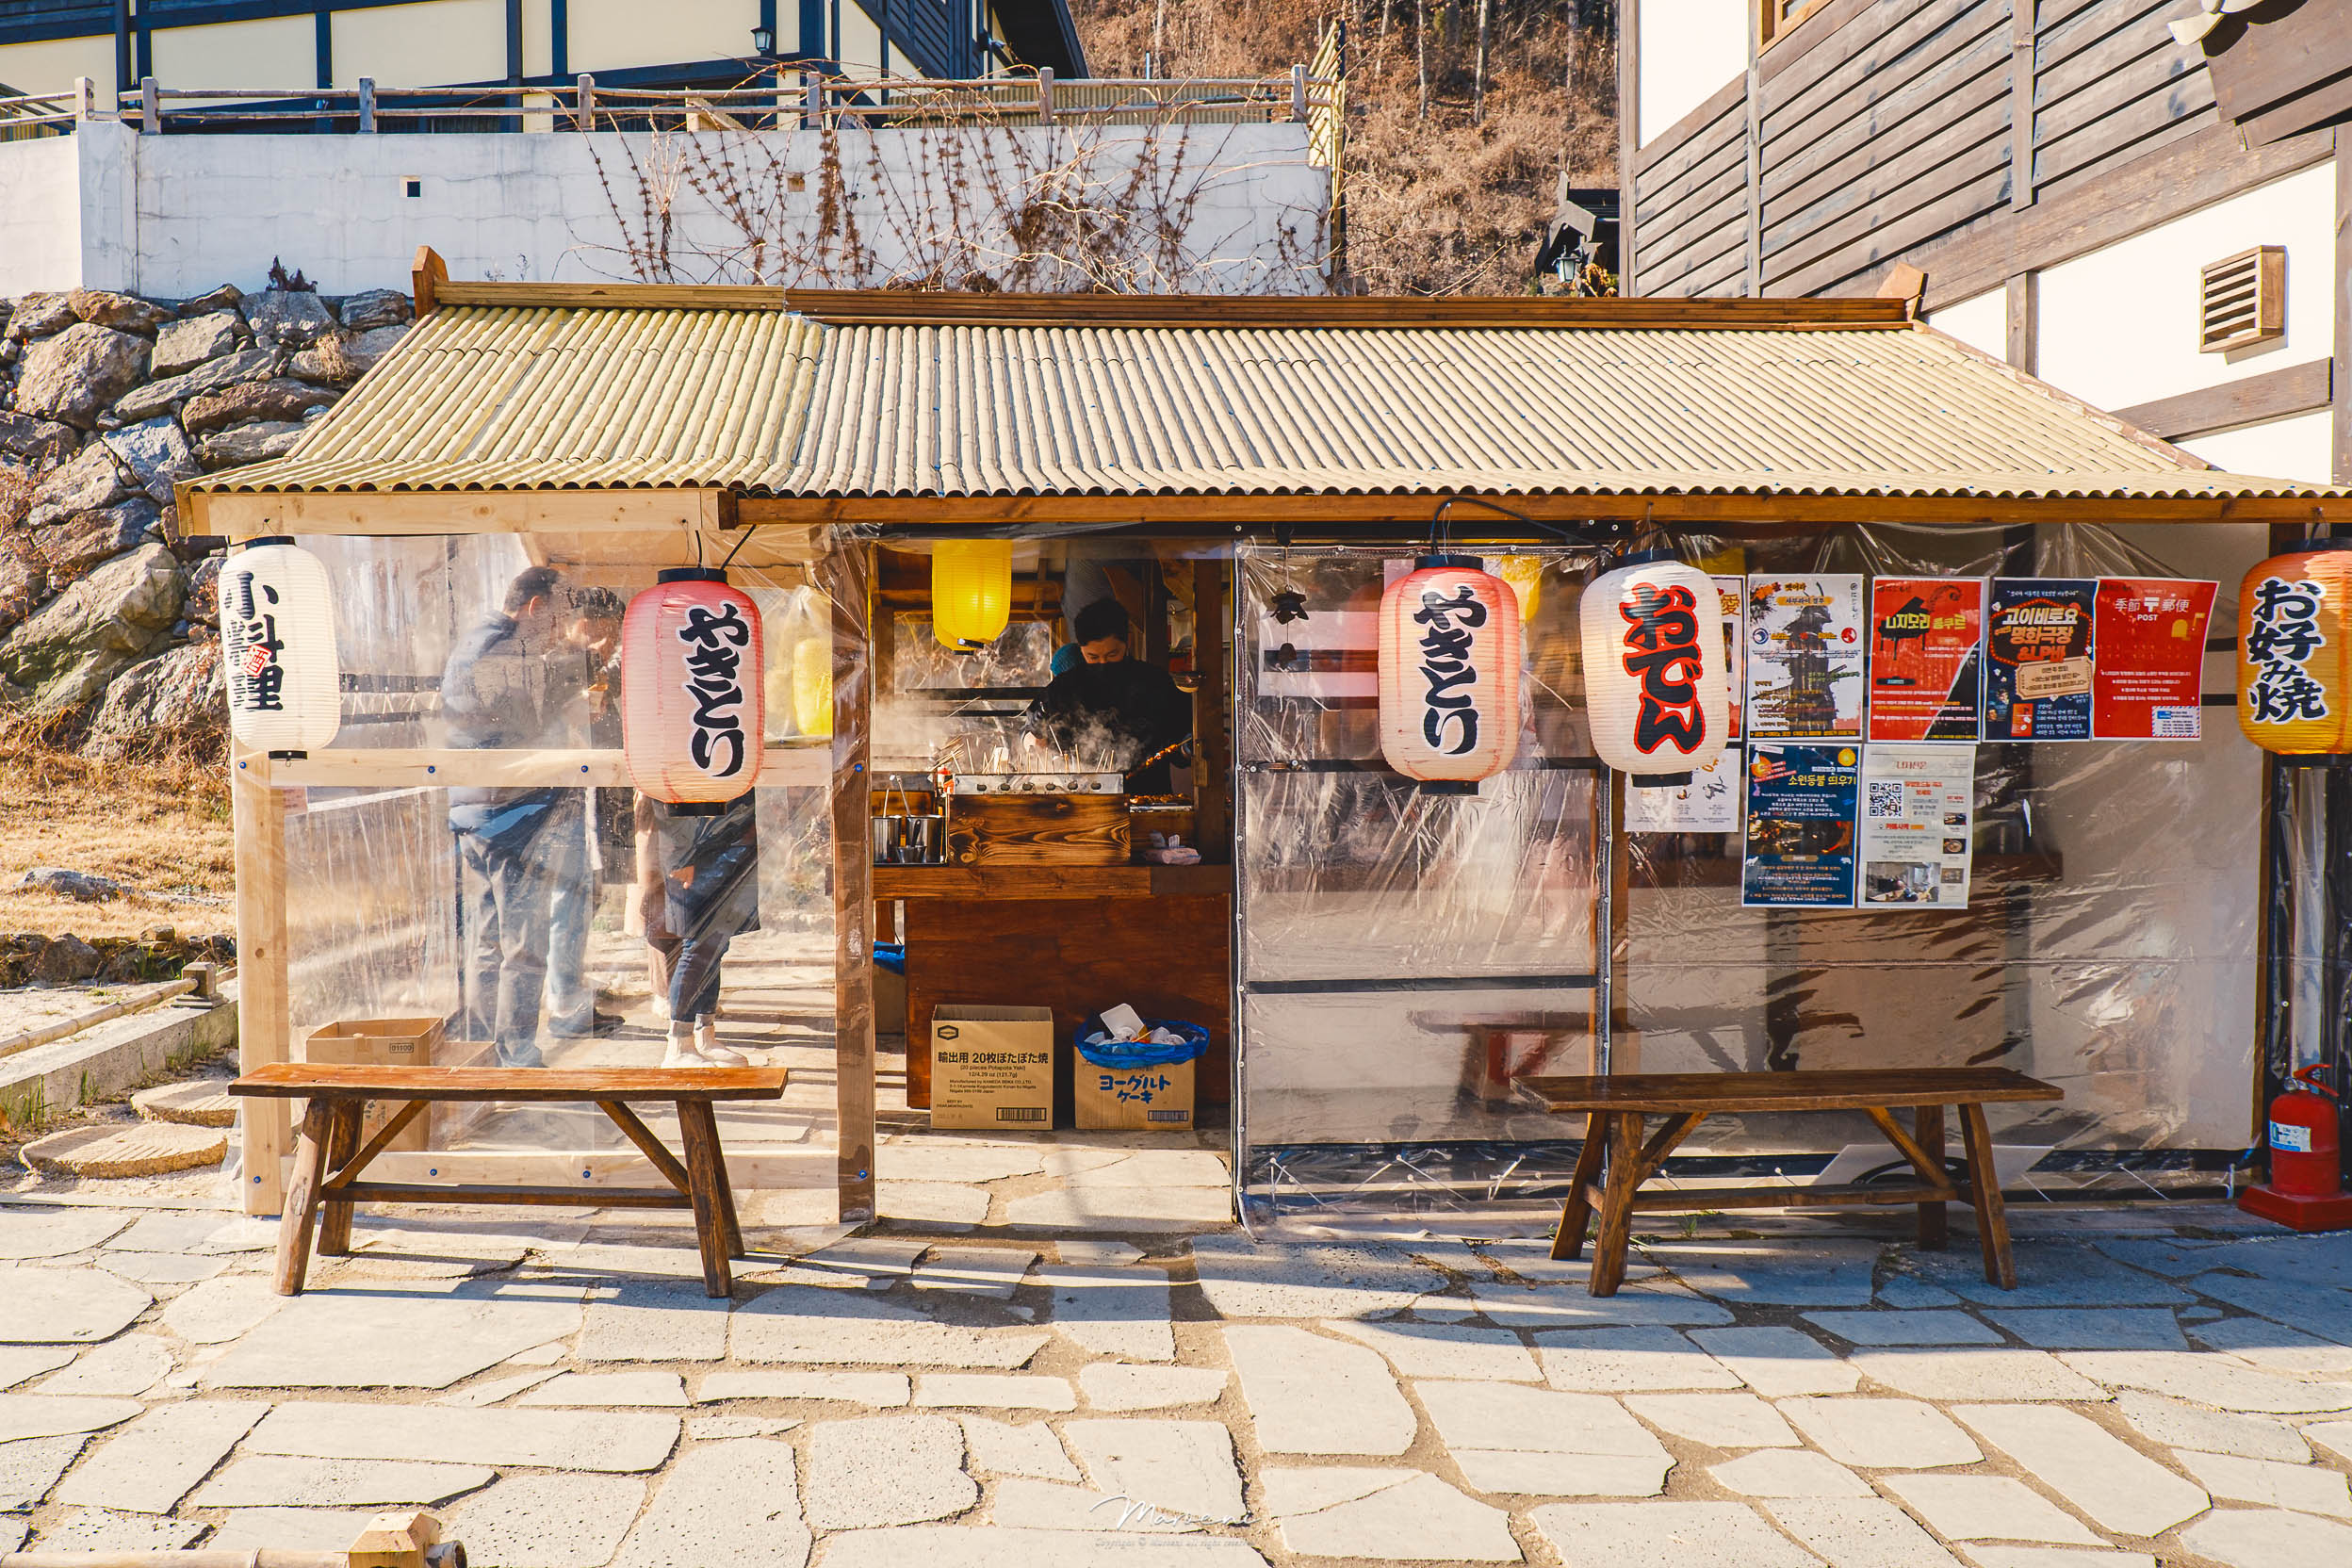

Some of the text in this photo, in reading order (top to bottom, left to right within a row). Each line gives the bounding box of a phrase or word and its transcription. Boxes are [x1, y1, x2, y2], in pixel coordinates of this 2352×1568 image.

[1721, 593, 1740, 616] 愛
[2115, 597, 2141, 612] 季節
[2162, 597, 2191, 612] 郵便
[1886, 612, 1931, 629] 니지모리
[2001, 608, 2079, 626] 고이비토요
[2010, 626, 2074, 645] 명화극장
[2246, 579, 2327, 723] お好み焼
[1413, 585, 1488, 755] やきとり
[1619, 581, 1706, 755] おでん
[679, 603, 750, 777] やきとり
[1788, 775, 1856, 788] 소원등불 띄우기
[938, 1052, 969, 1064] 輸出用
[1099, 1073, 1171, 1092] ヨーグルト
[1117, 1089, 1153, 1104] ケーキ
